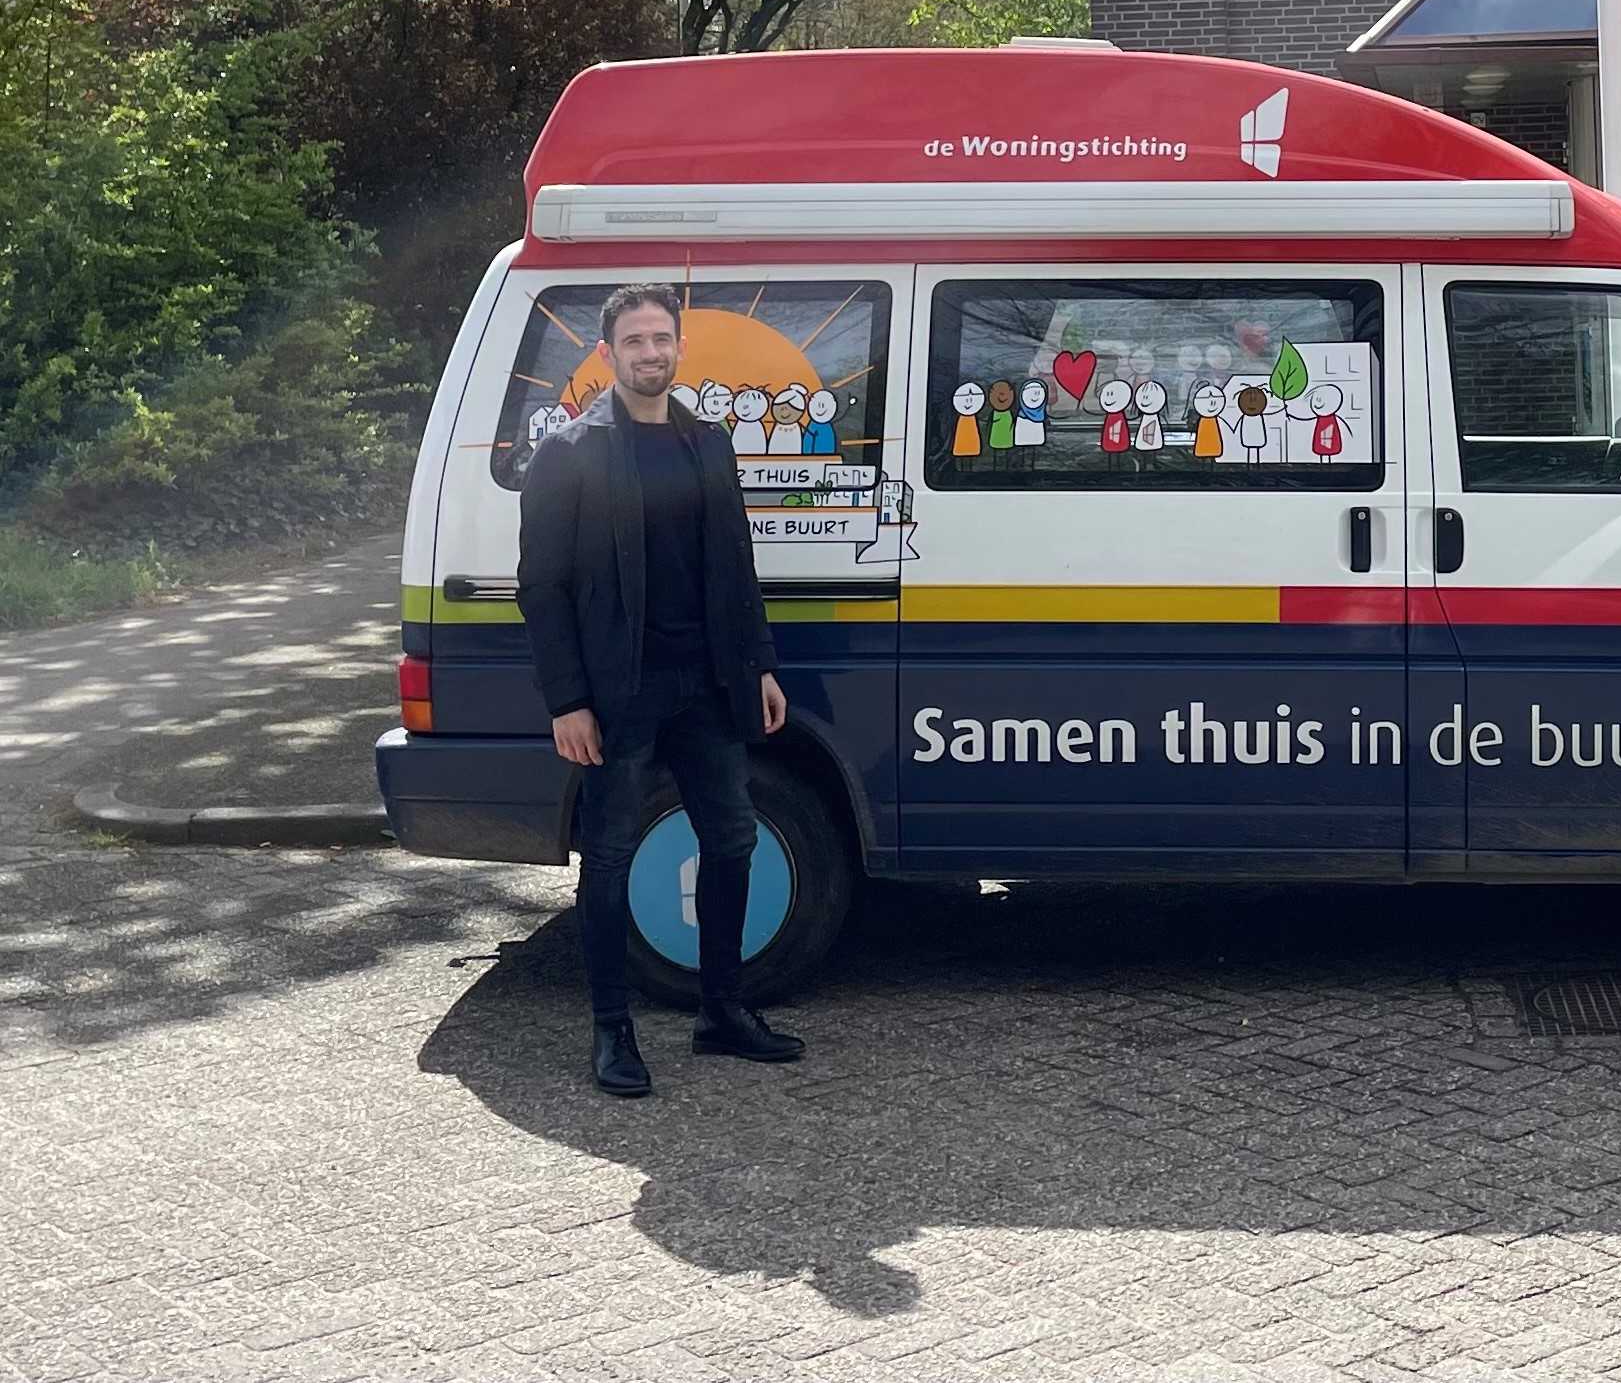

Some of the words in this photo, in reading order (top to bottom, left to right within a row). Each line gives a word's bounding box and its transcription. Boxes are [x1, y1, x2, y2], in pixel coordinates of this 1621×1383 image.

[923, 139, 954, 157] de
[961, 134, 1188, 163] Woningstichting
[754, 469, 810, 483] THUIS
[785, 520, 850, 535] BUURT
[911, 706, 1138, 765] Samen
[1161, 702, 1327, 765] thuis
[1350, 705, 1401, 765] in
[1428, 703, 1504, 767] de
